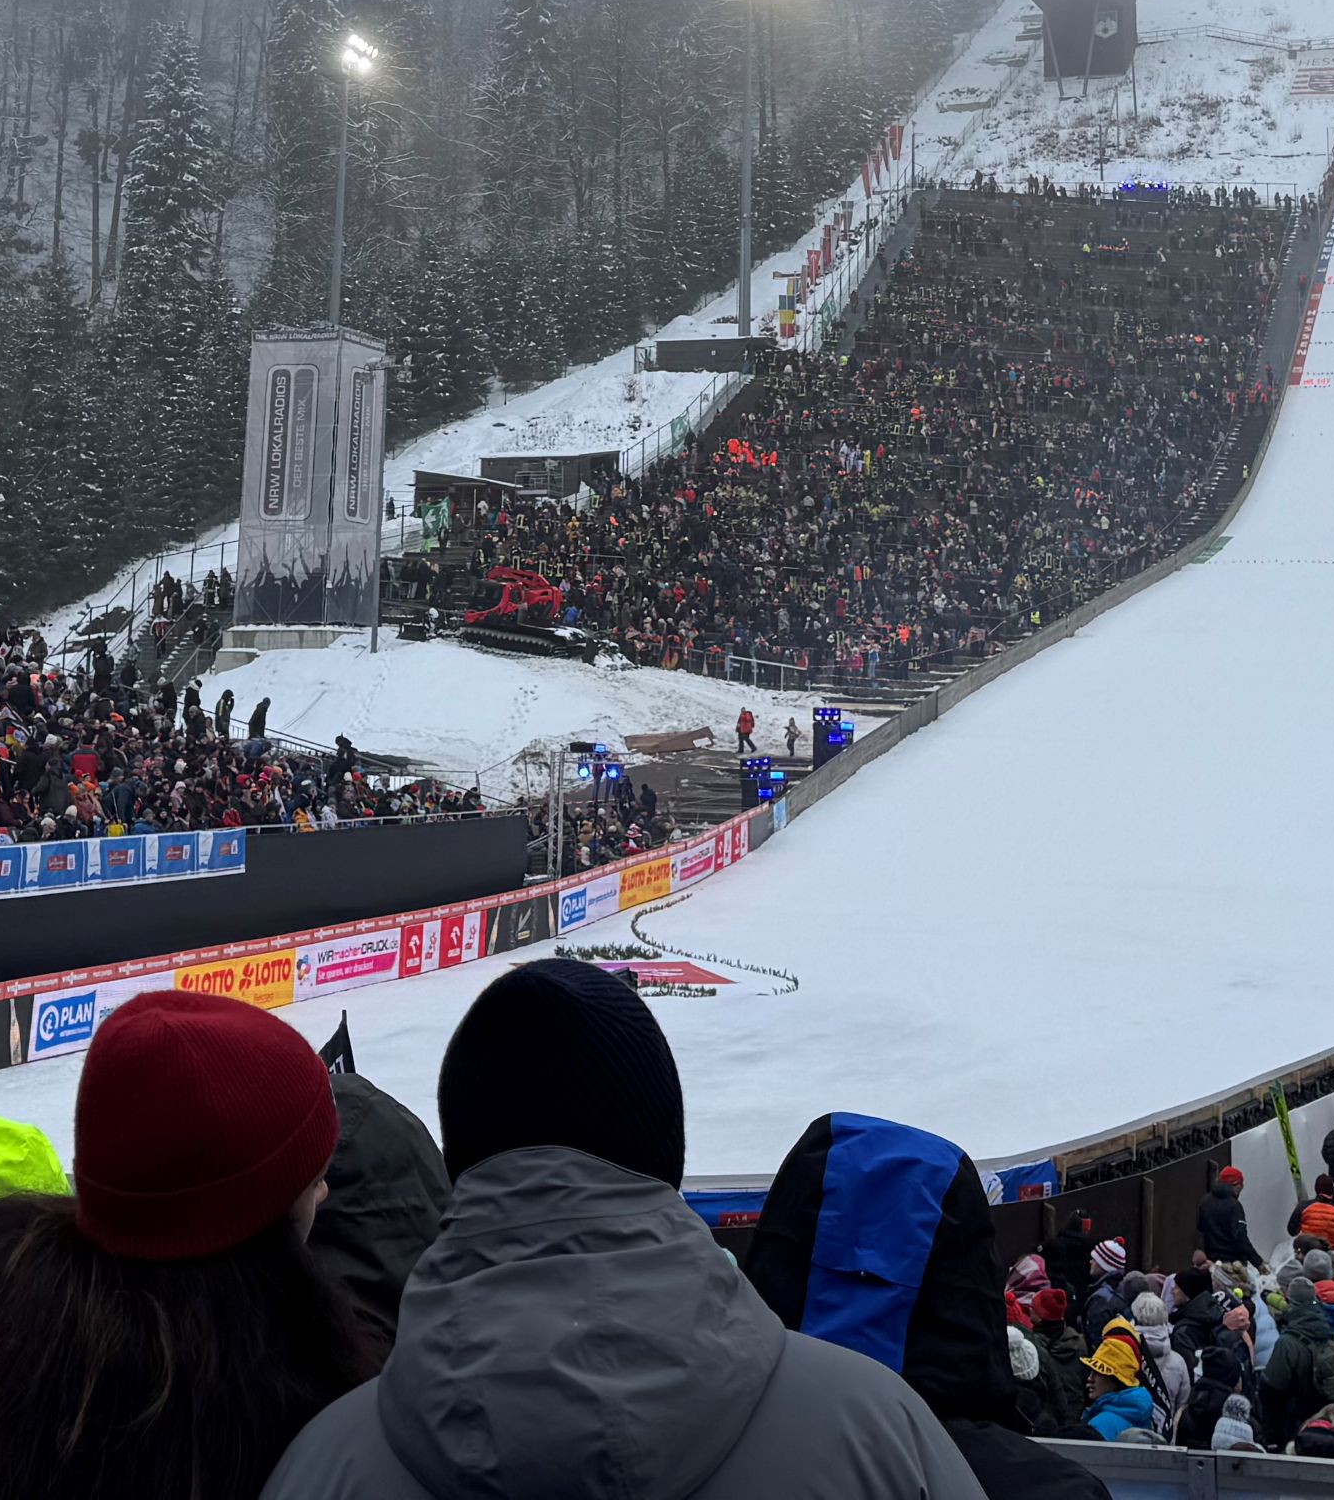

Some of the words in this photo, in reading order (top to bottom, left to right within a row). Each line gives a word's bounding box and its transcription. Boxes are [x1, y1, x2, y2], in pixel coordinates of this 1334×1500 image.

[1297, 310, 1316, 355] HESSEN
[271, 376, 287, 469] LOKALRADIOS
[294, 424, 305, 462] BESTE
[268, 473, 280, 509] NRW
[293, 463, 302, 488] DER
[348, 476, 357, 510] NRW
[195, 968, 234, 994] LOTTO
[254, 957, 292, 987] LOTTO
[60, 1001, 93, 1027] PLAN
